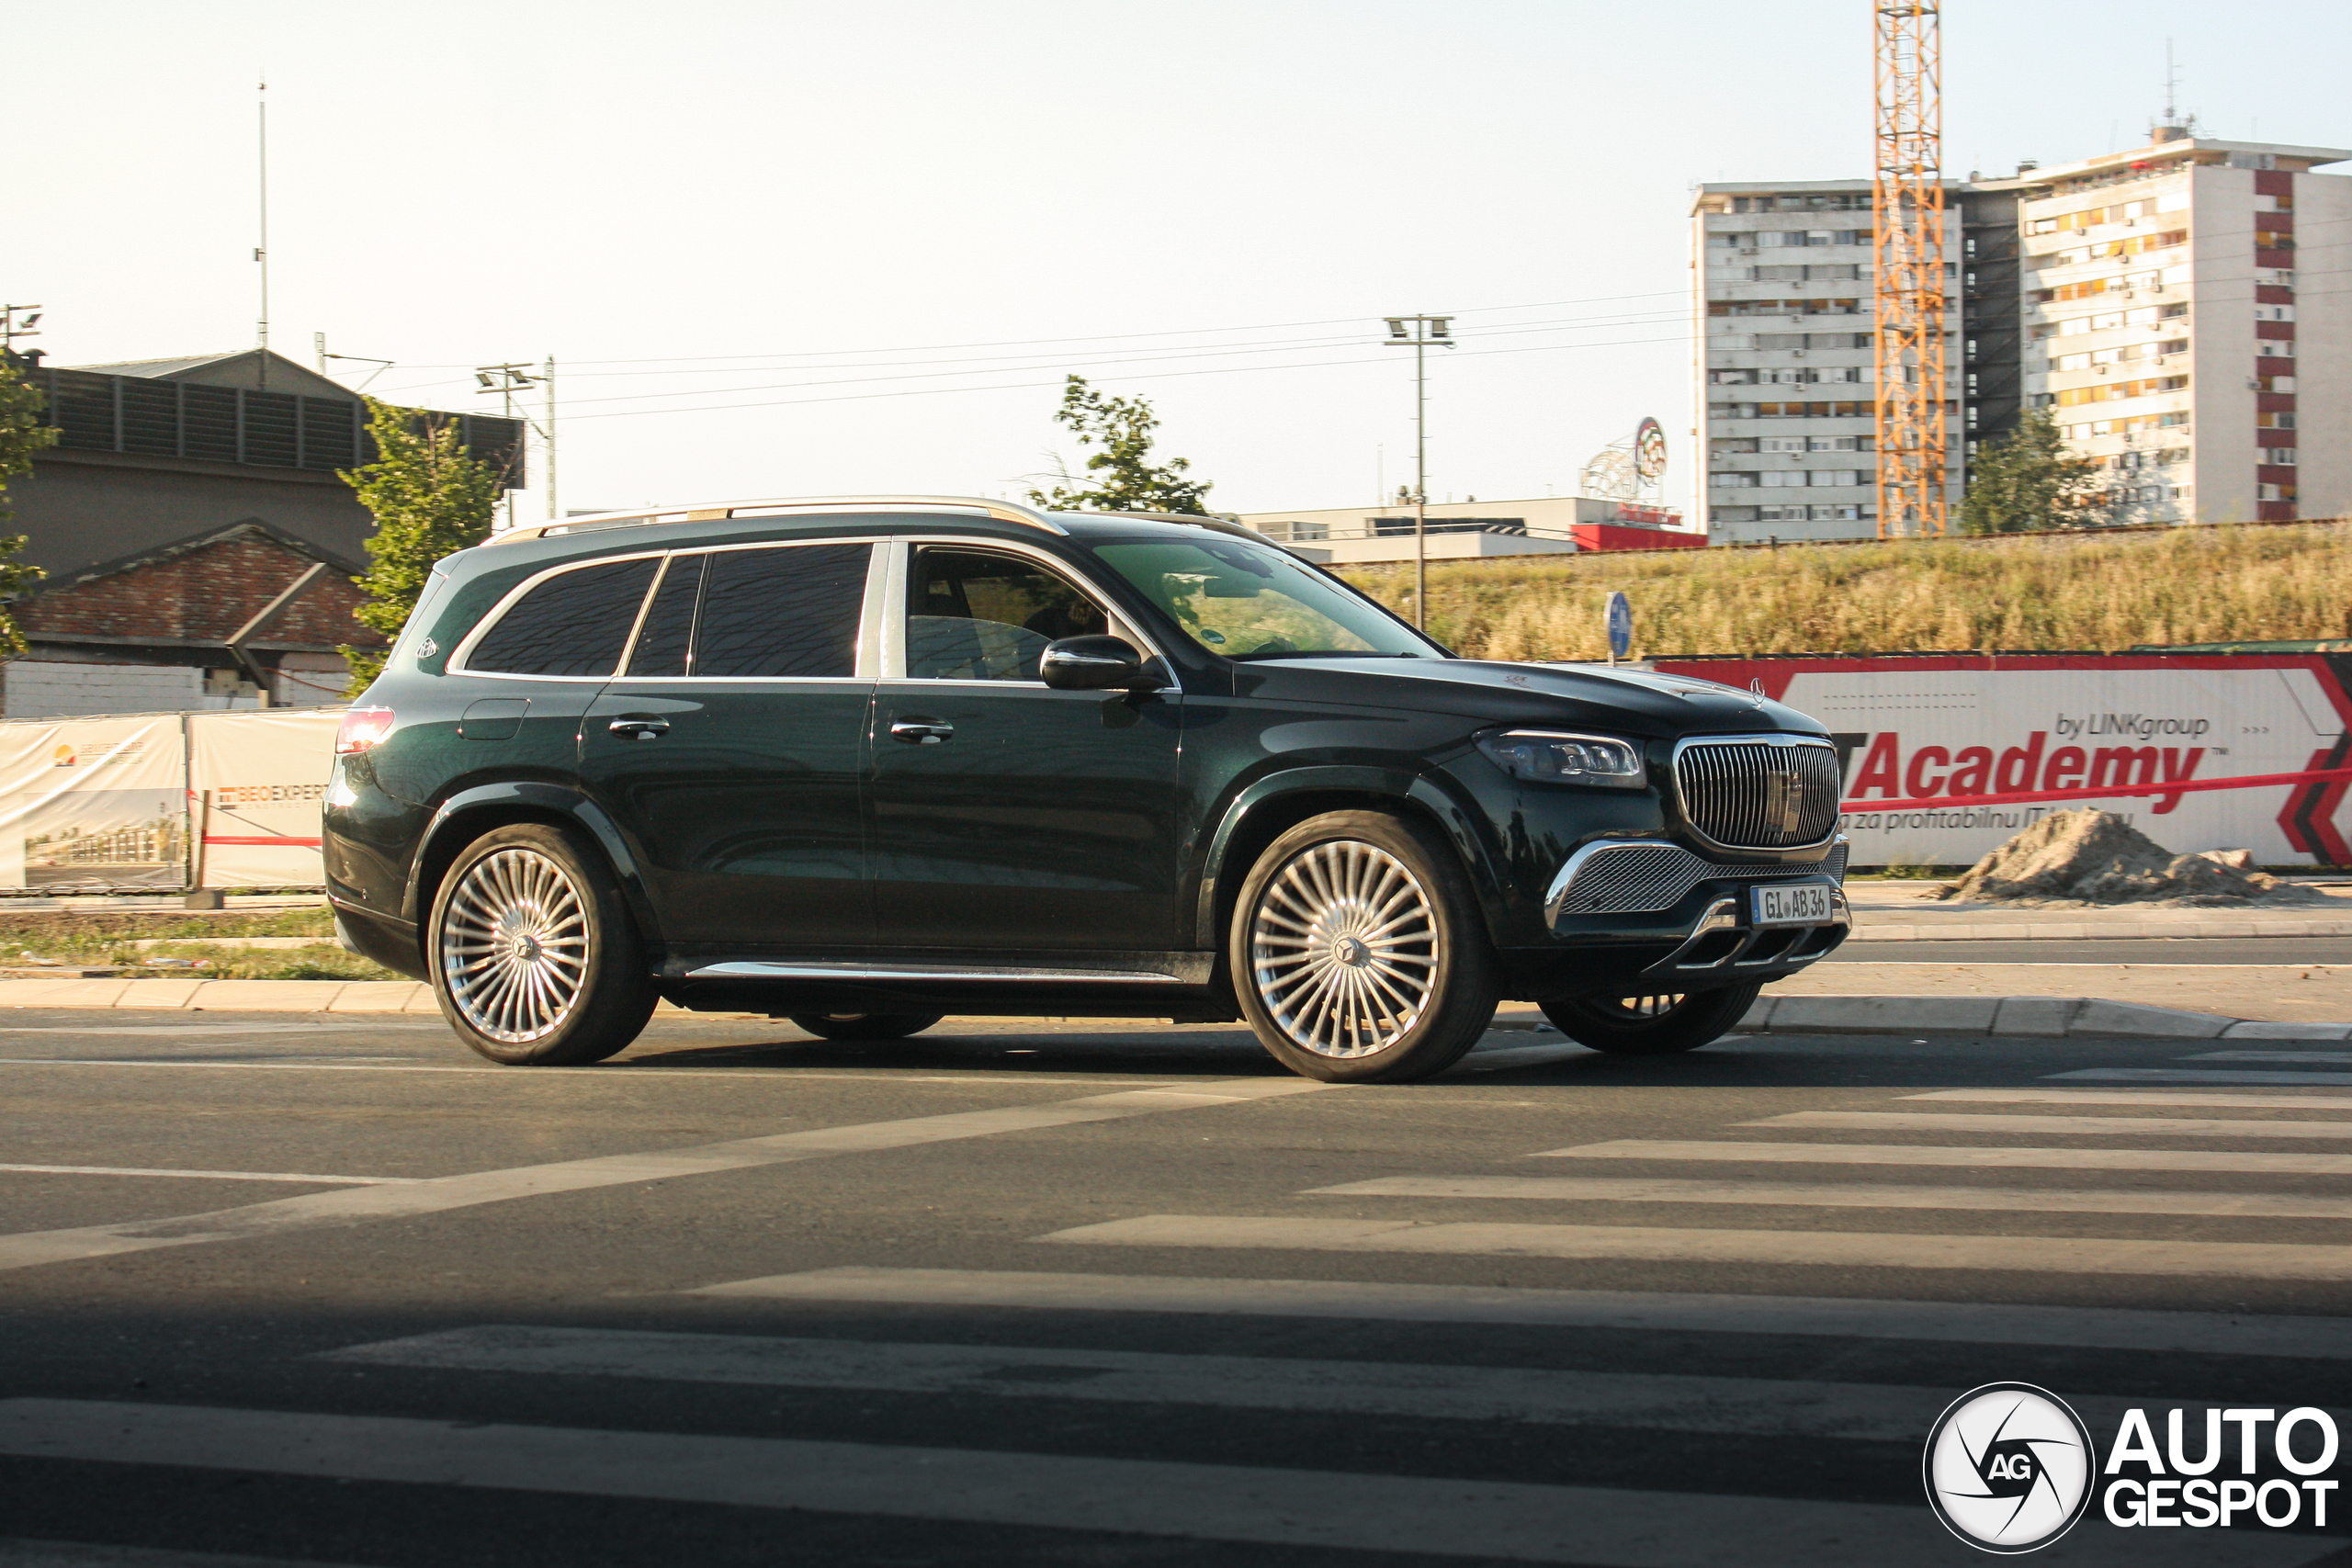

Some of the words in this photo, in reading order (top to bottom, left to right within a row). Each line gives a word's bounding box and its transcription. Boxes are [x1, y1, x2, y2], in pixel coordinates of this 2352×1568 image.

[2055, 713, 2085, 740] by
[2087, 713, 2210, 740] LINKgroup
[1853, 814, 1882, 829] za
[1884, 807, 2018, 834] profitabilnu
[1792, 889, 1808, 917] AB
[1810, 889, 1825, 916] 36
